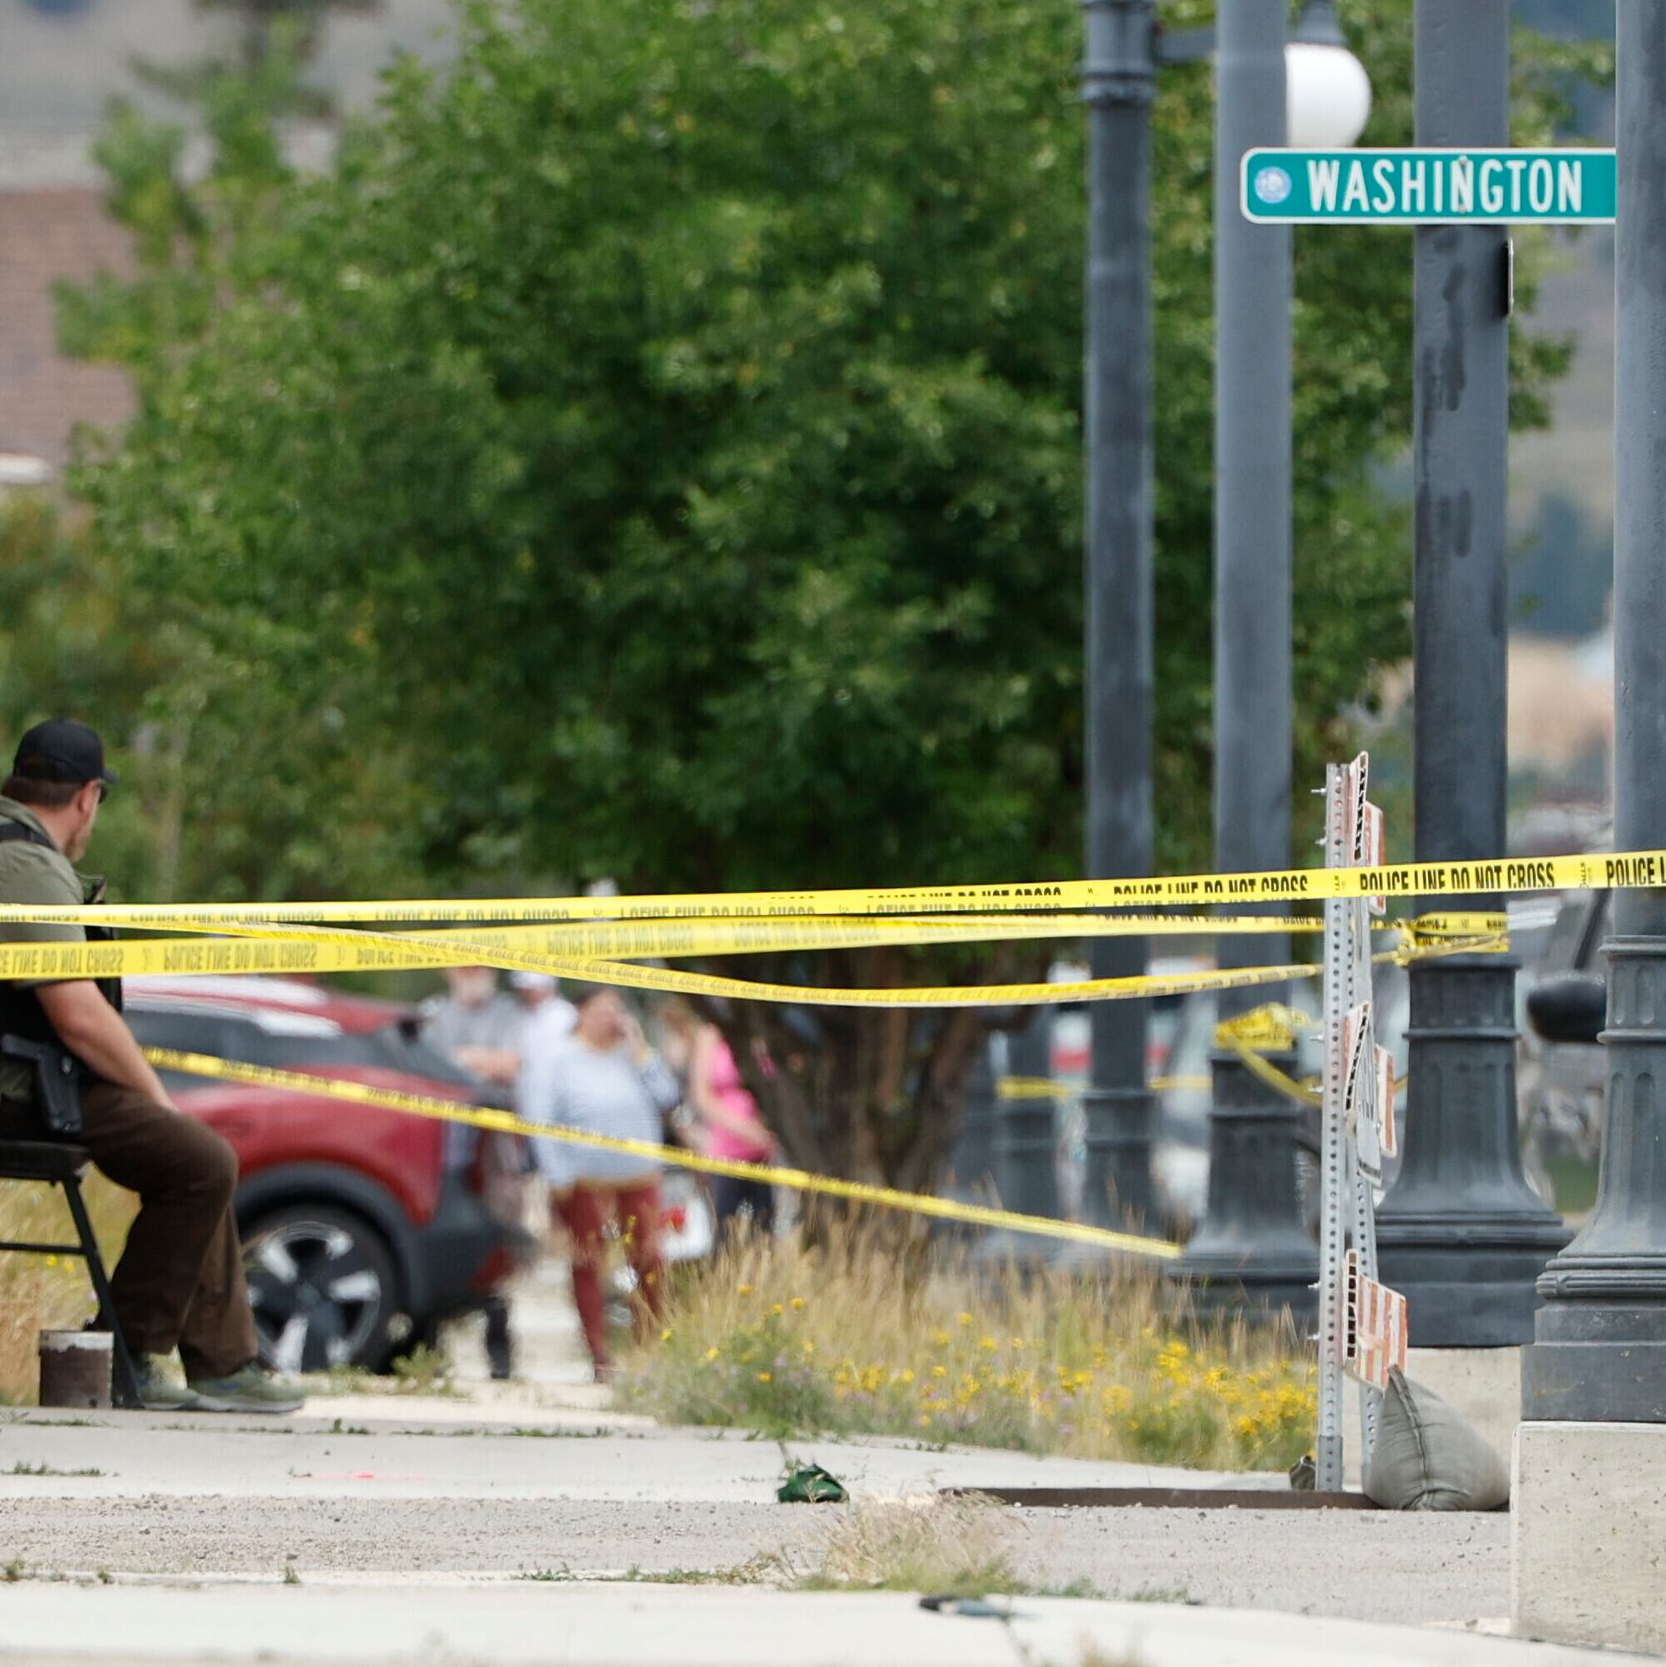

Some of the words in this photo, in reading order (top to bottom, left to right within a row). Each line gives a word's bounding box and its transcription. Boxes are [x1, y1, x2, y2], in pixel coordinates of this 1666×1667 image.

[1306, 159, 1582, 213] WASHINGTON
[1475, 865, 1502, 889] NOT
[1507, 862, 1555, 888] CROSS
[1605, 857, 1655, 887] POLICE
